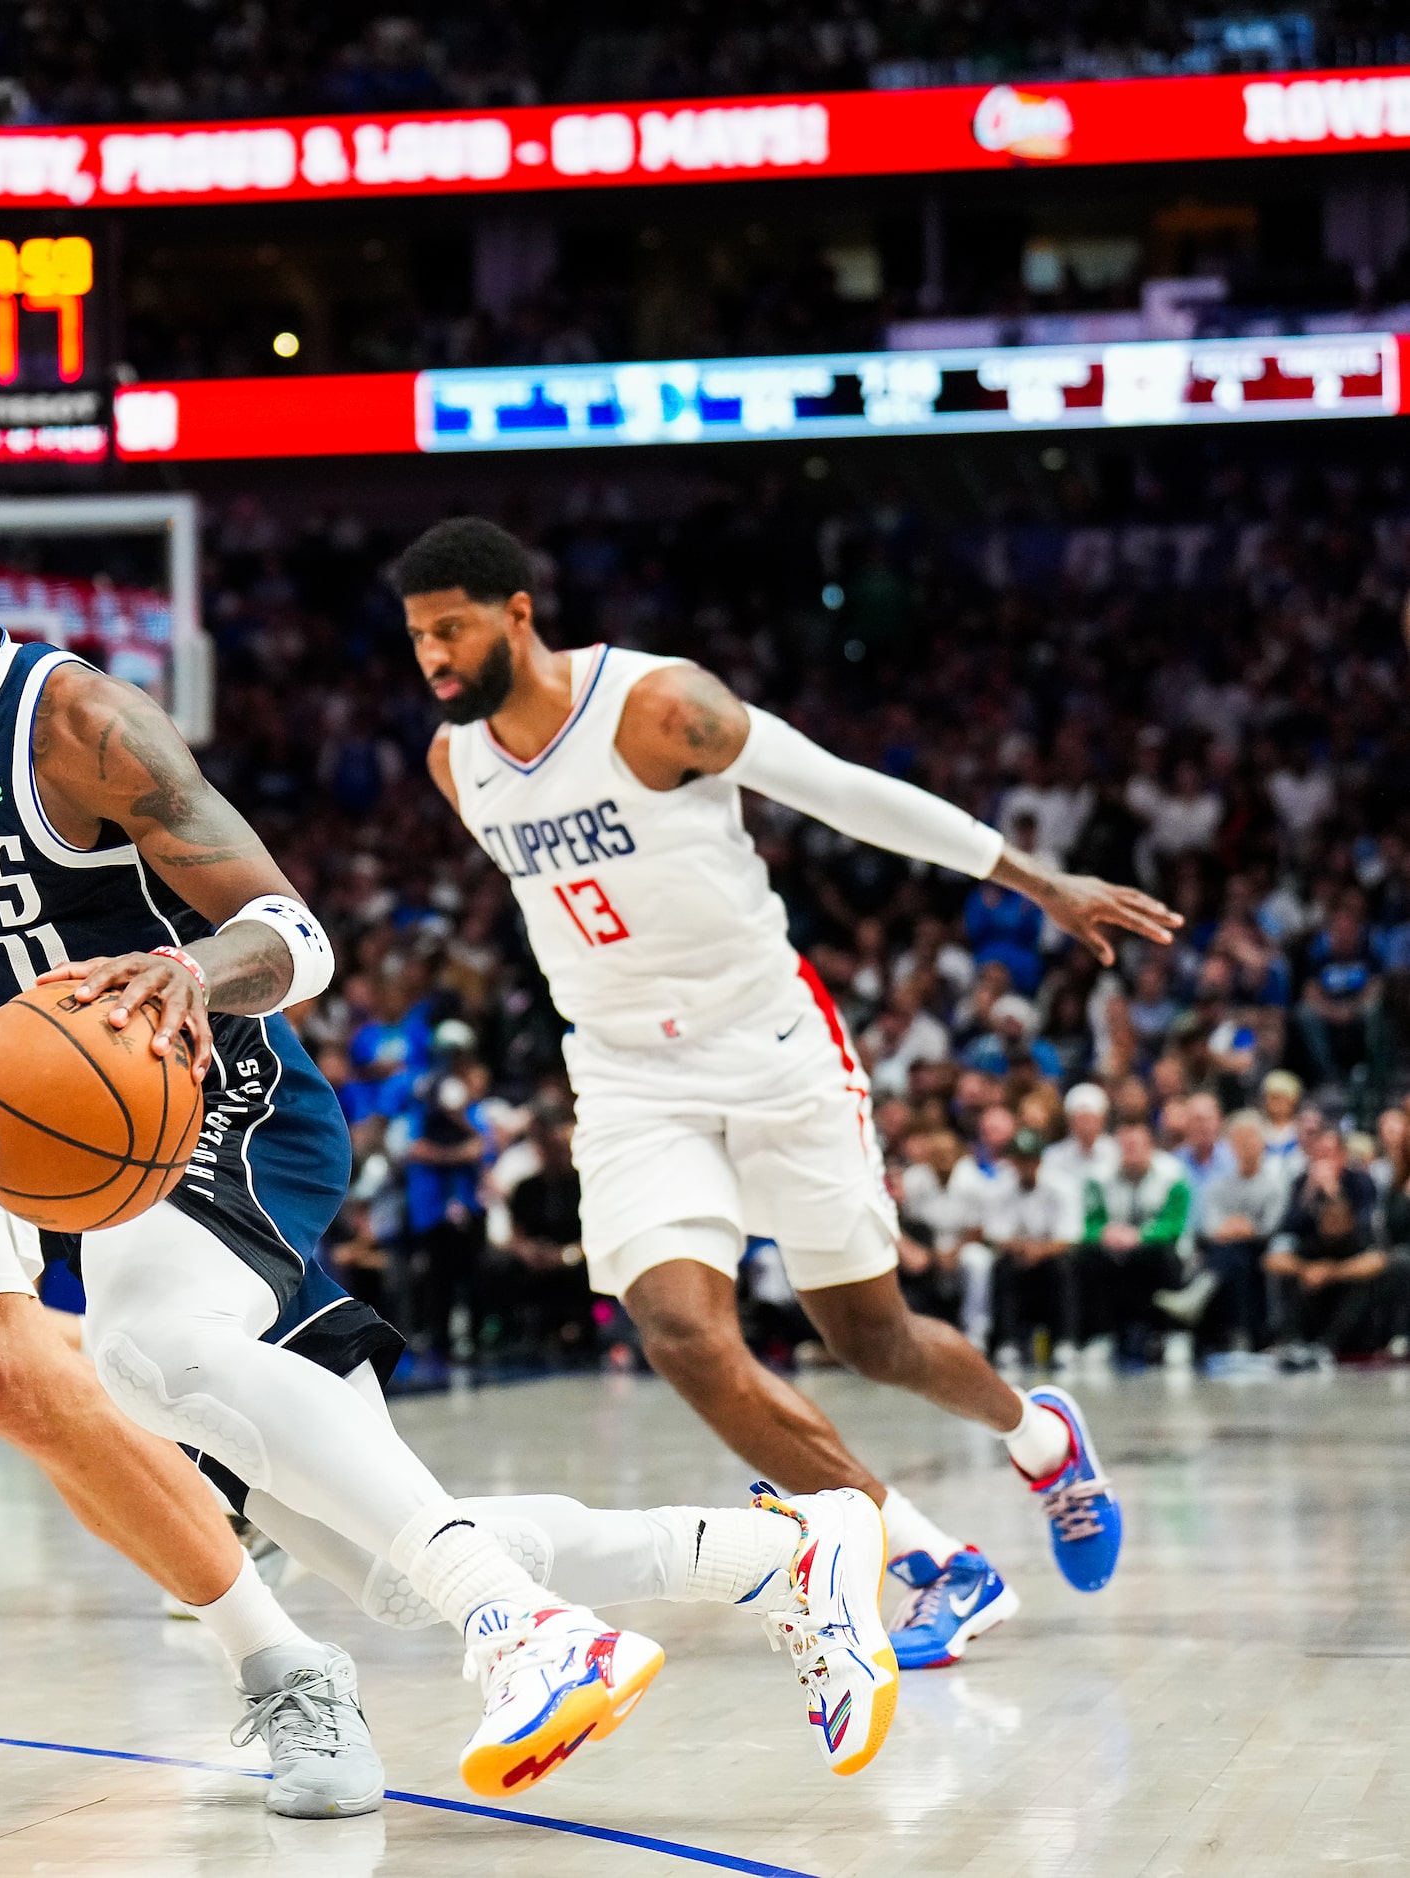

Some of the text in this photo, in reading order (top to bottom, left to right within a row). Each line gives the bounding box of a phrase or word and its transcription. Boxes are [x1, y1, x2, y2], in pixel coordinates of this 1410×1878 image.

[100, 128, 296, 194] PROUD
[354, 119, 511, 184] LOUD
[639, 103, 829, 171] MAVS!
[552, 877, 631, 947] 13
